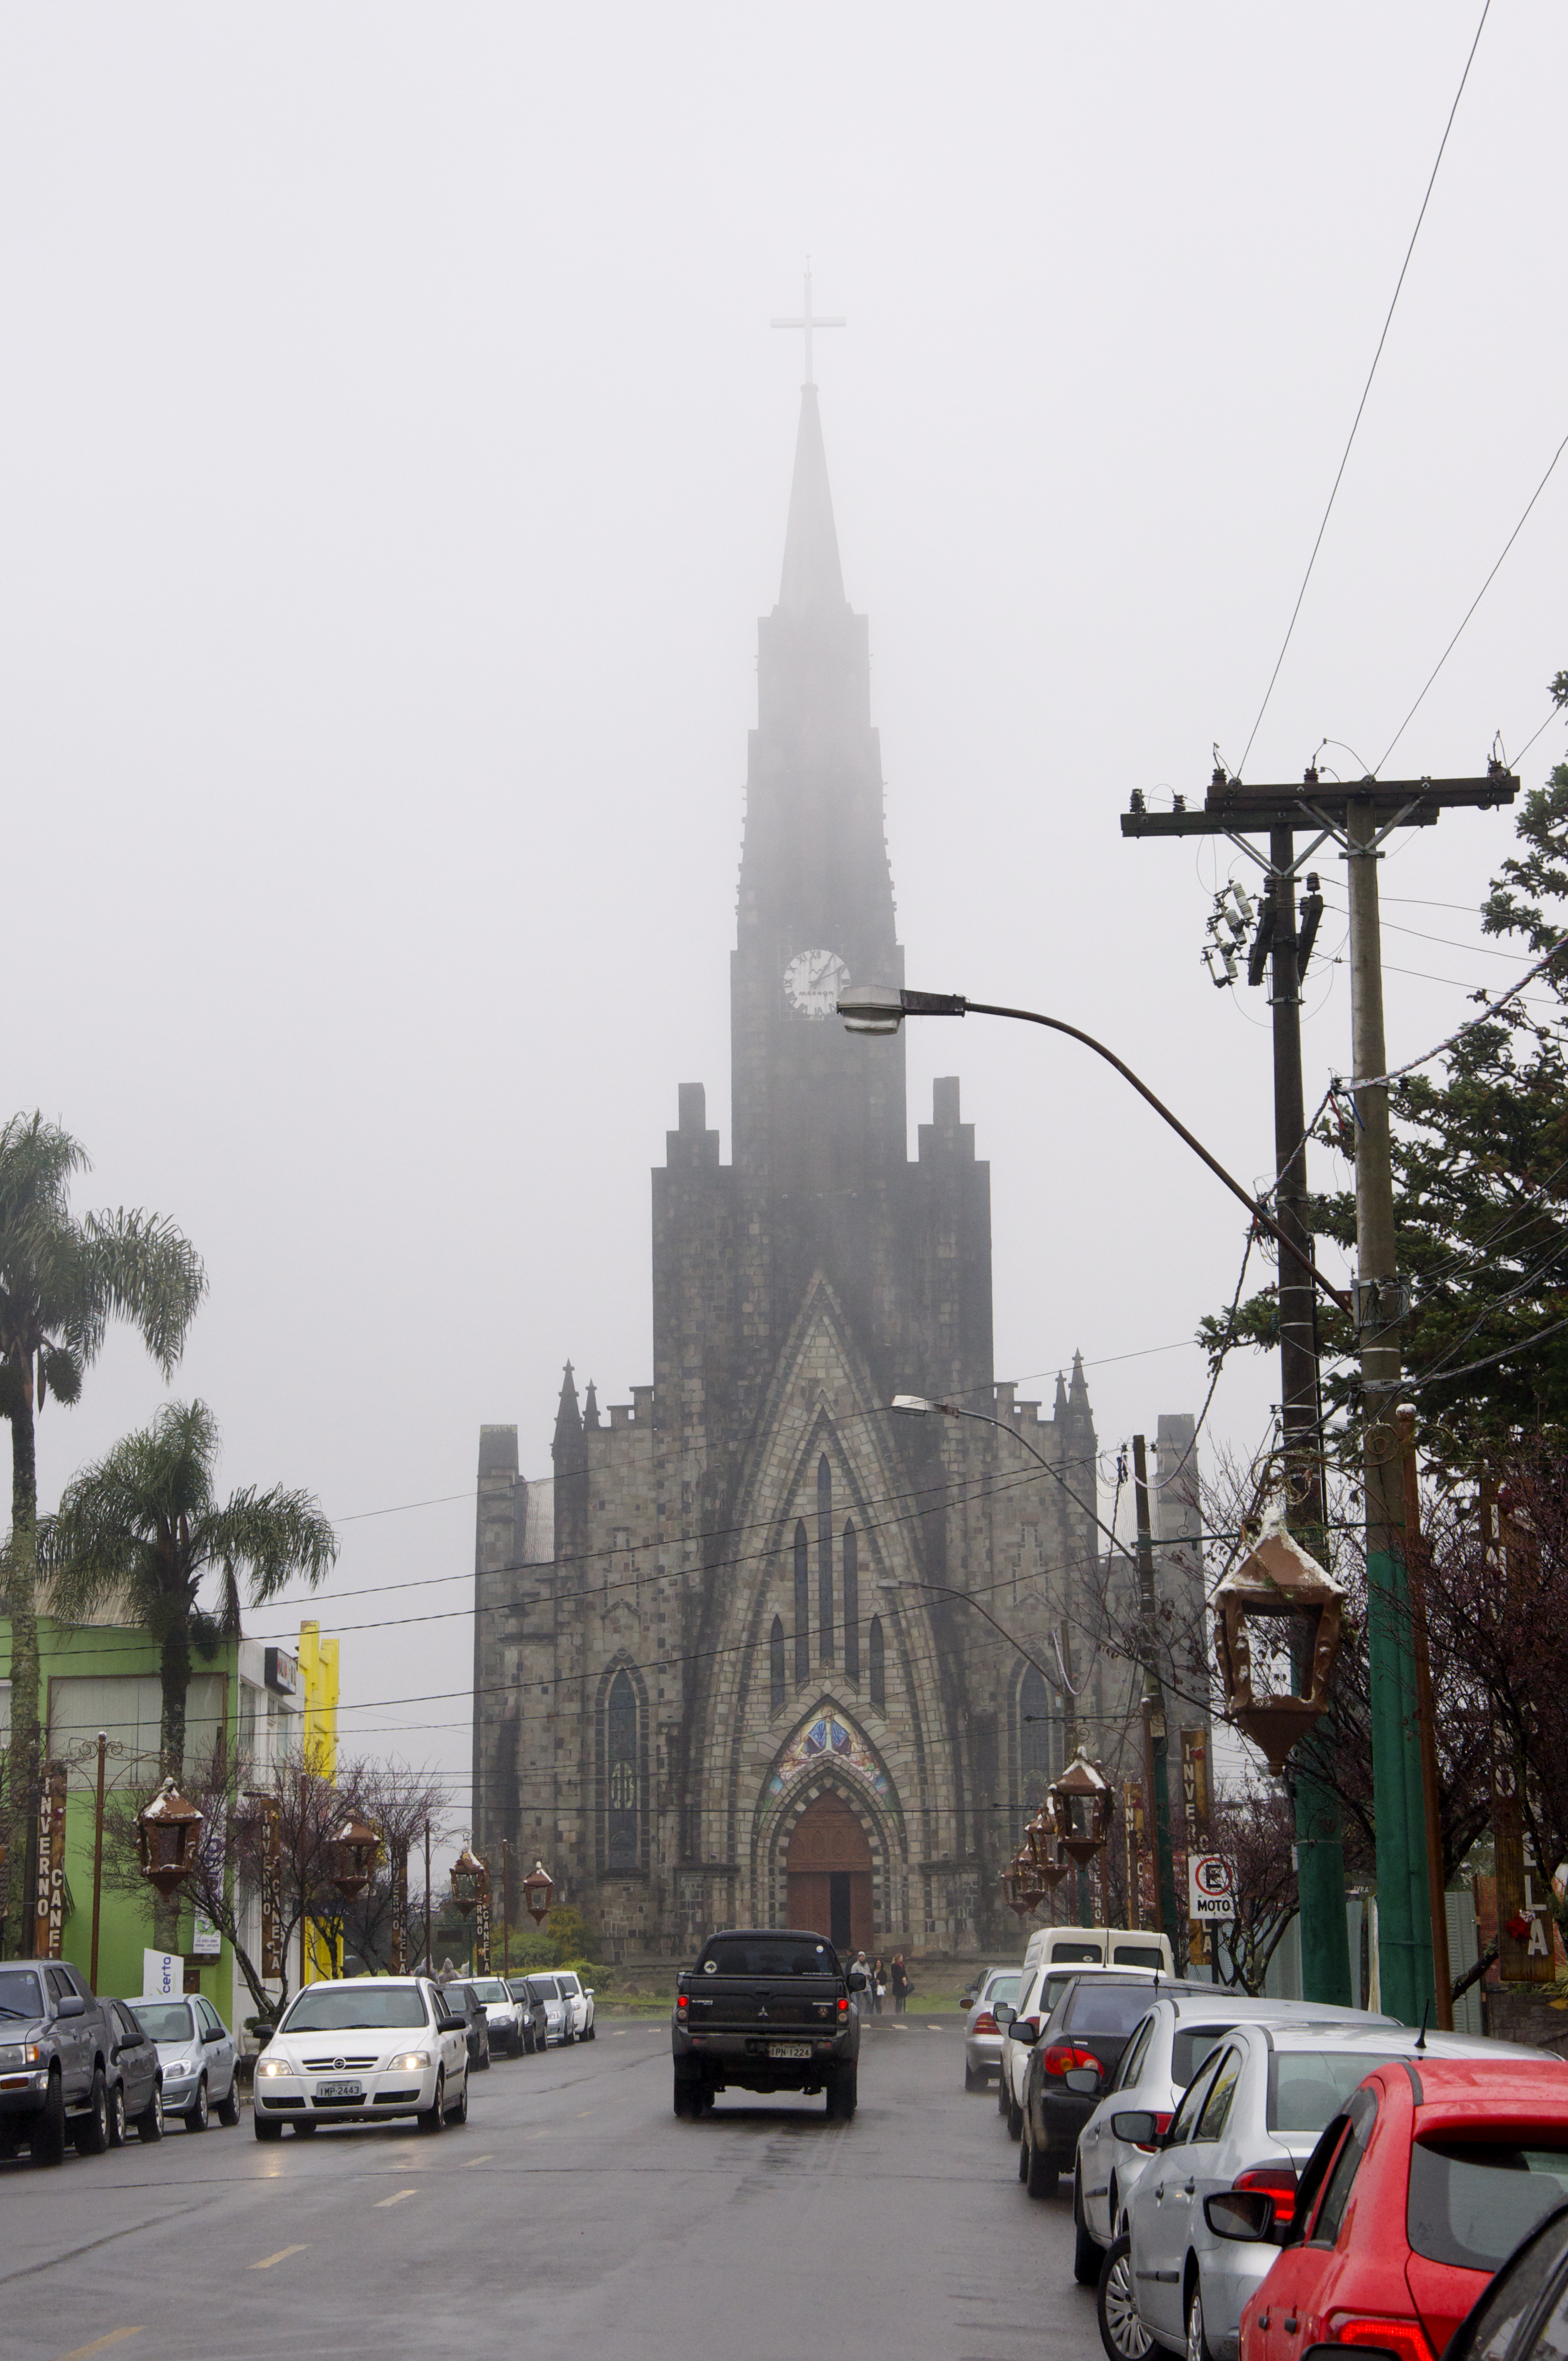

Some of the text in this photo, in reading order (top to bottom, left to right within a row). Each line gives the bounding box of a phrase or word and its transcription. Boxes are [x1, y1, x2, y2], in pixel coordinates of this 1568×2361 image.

[37, 1777, 53, 1916] INVERNO
[1206, 1864, 1222, 1888] E
[48, 1869, 63, 1959] CANE
[272, 1879, 281, 1970] CANELA
[1197, 1900, 1231, 1912] MOTO
[161, 1956, 171, 1993] certa
